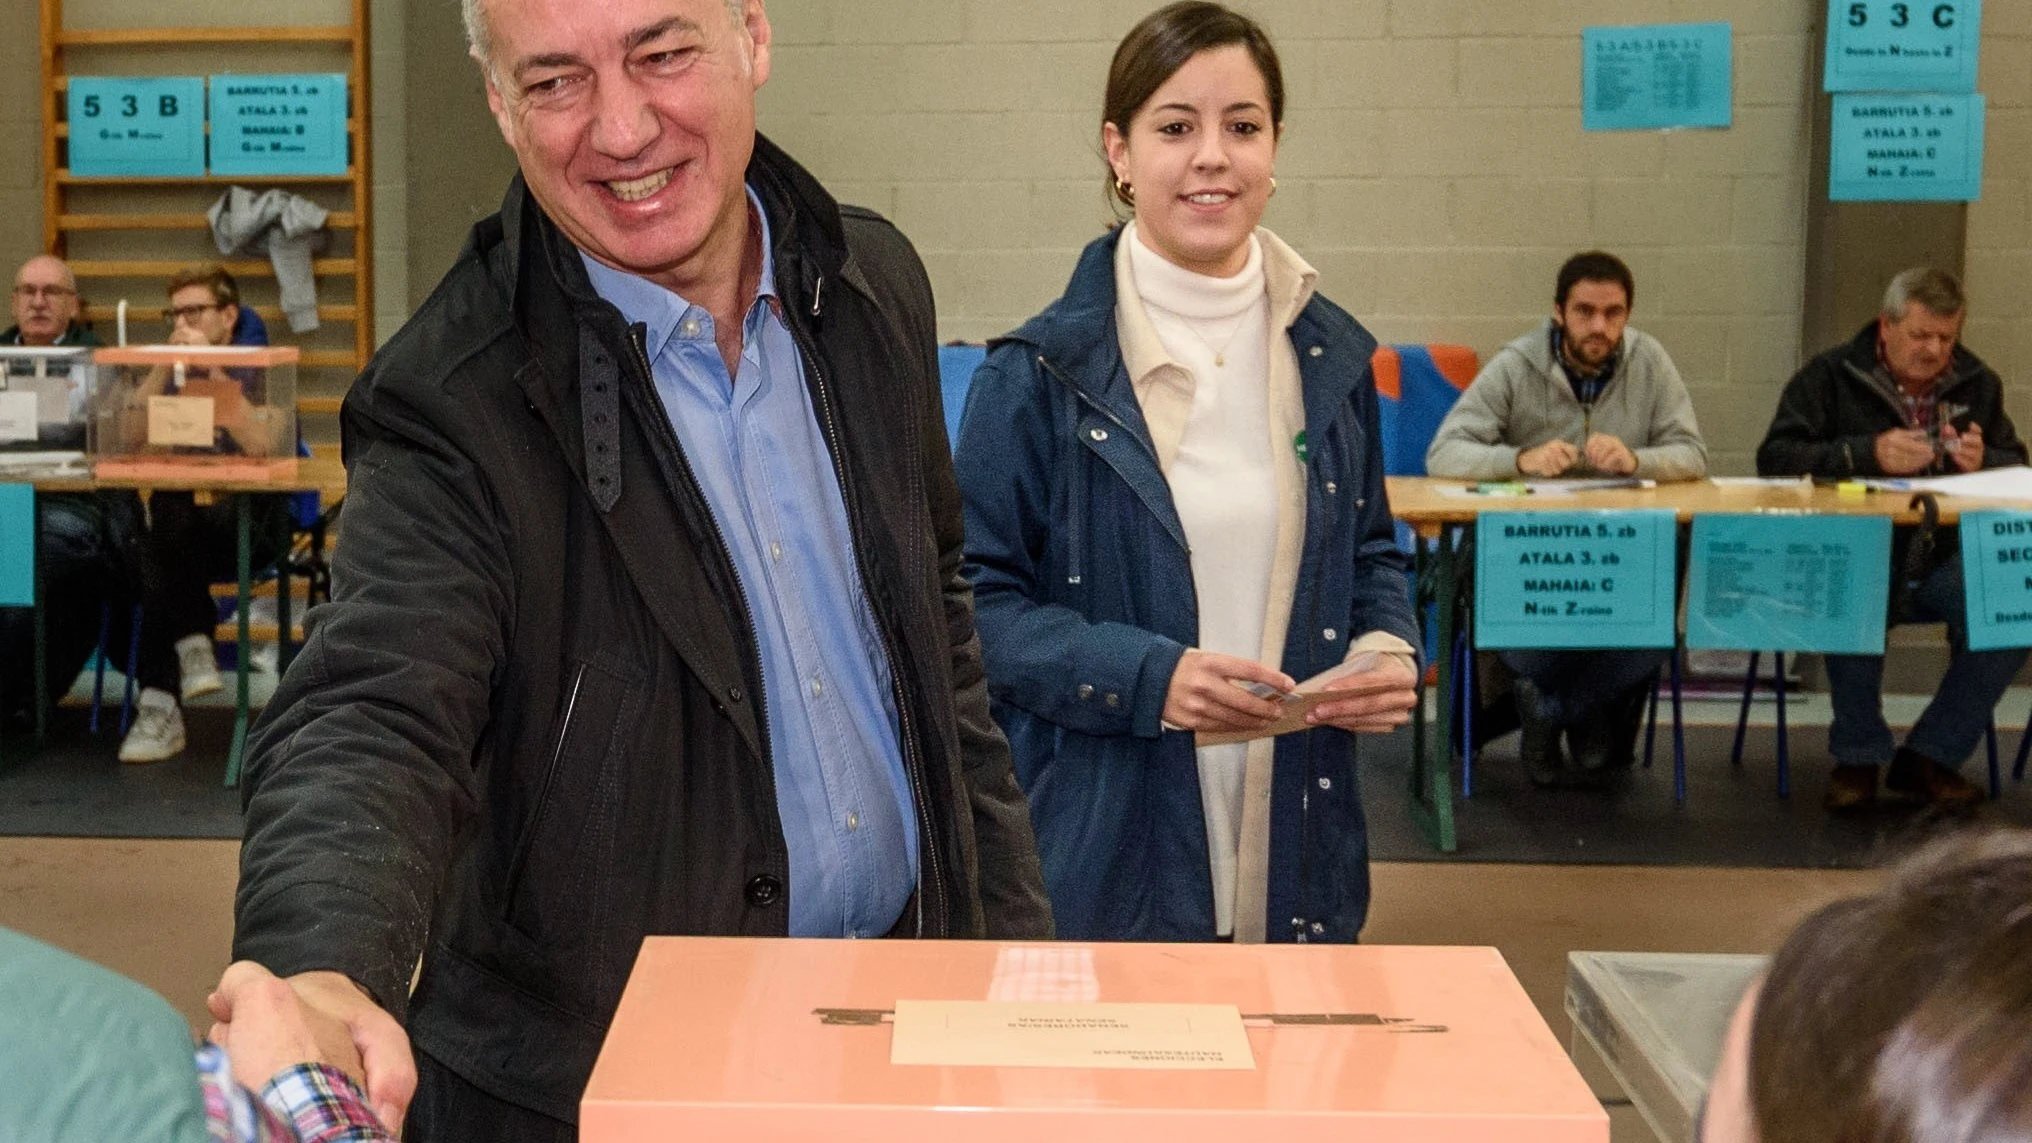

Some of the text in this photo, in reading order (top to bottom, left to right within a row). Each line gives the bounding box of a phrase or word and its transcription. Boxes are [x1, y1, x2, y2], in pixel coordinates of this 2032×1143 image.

[1848, 2, 1955, 29] 5 3 C
[1889, 45, 1900, 56] N
[84, 94, 178, 117] 5 3 B
[1863, 127, 1906, 138] ATALA
[1503, 523, 1637, 538] BARRUTIA 5. zb
[1519, 551, 1575, 565] ATALA
[1580, 550, 1597, 566] 3.
[1523, 576, 1614, 593] MAHAIA: C
